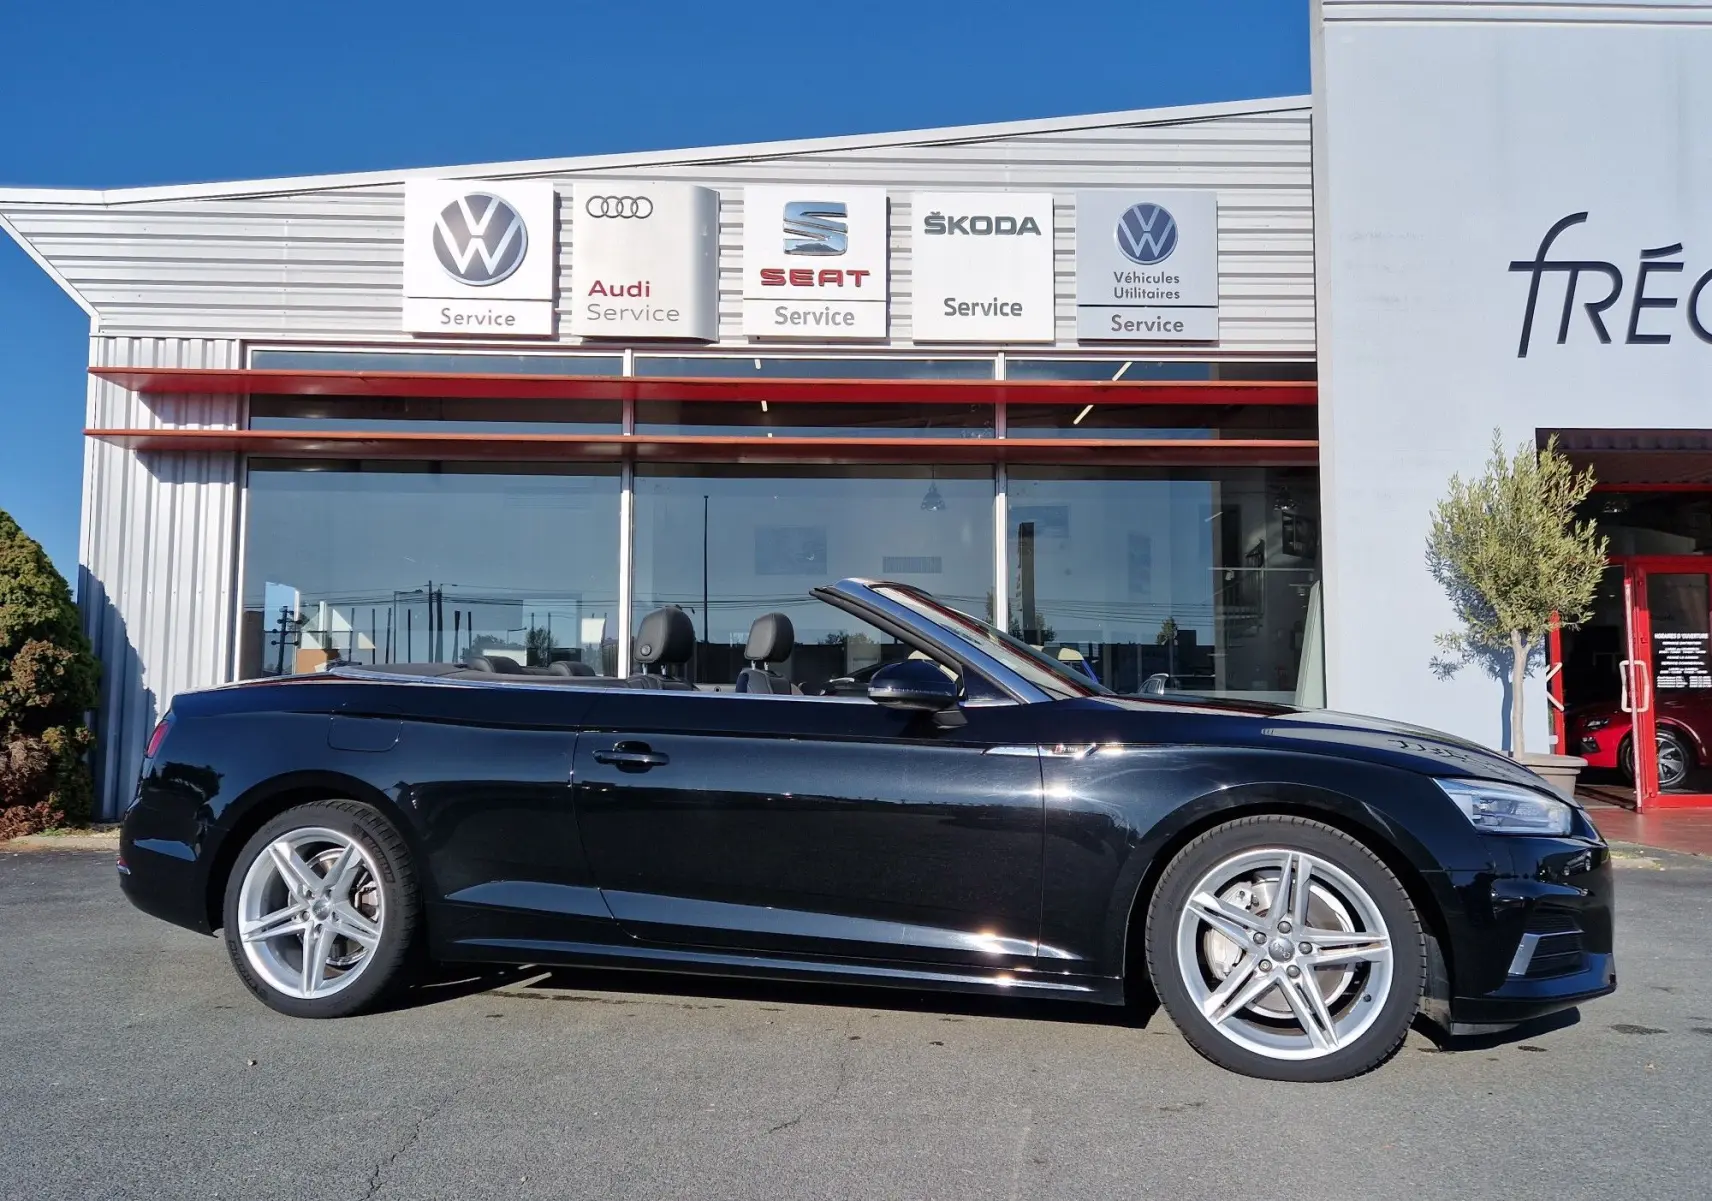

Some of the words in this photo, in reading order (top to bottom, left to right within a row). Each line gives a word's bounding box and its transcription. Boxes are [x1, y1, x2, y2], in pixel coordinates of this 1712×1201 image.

[923, 211, 1042, 236] ŠKODA
[759, 268, 871, 288] SEAT
[1113, 270, 1180, 284] Véhicules
[587, 279, 650, 298] Audi
[1113, 286, 1181, 300] Utilitaires
[440, 307, 516, 327] Service
[586, 303, 680, 322] Service
[774, 305, 855, 326] Service
[943, 296, 1023, 318] Service
[1110, 313, 1185, 333] Service
